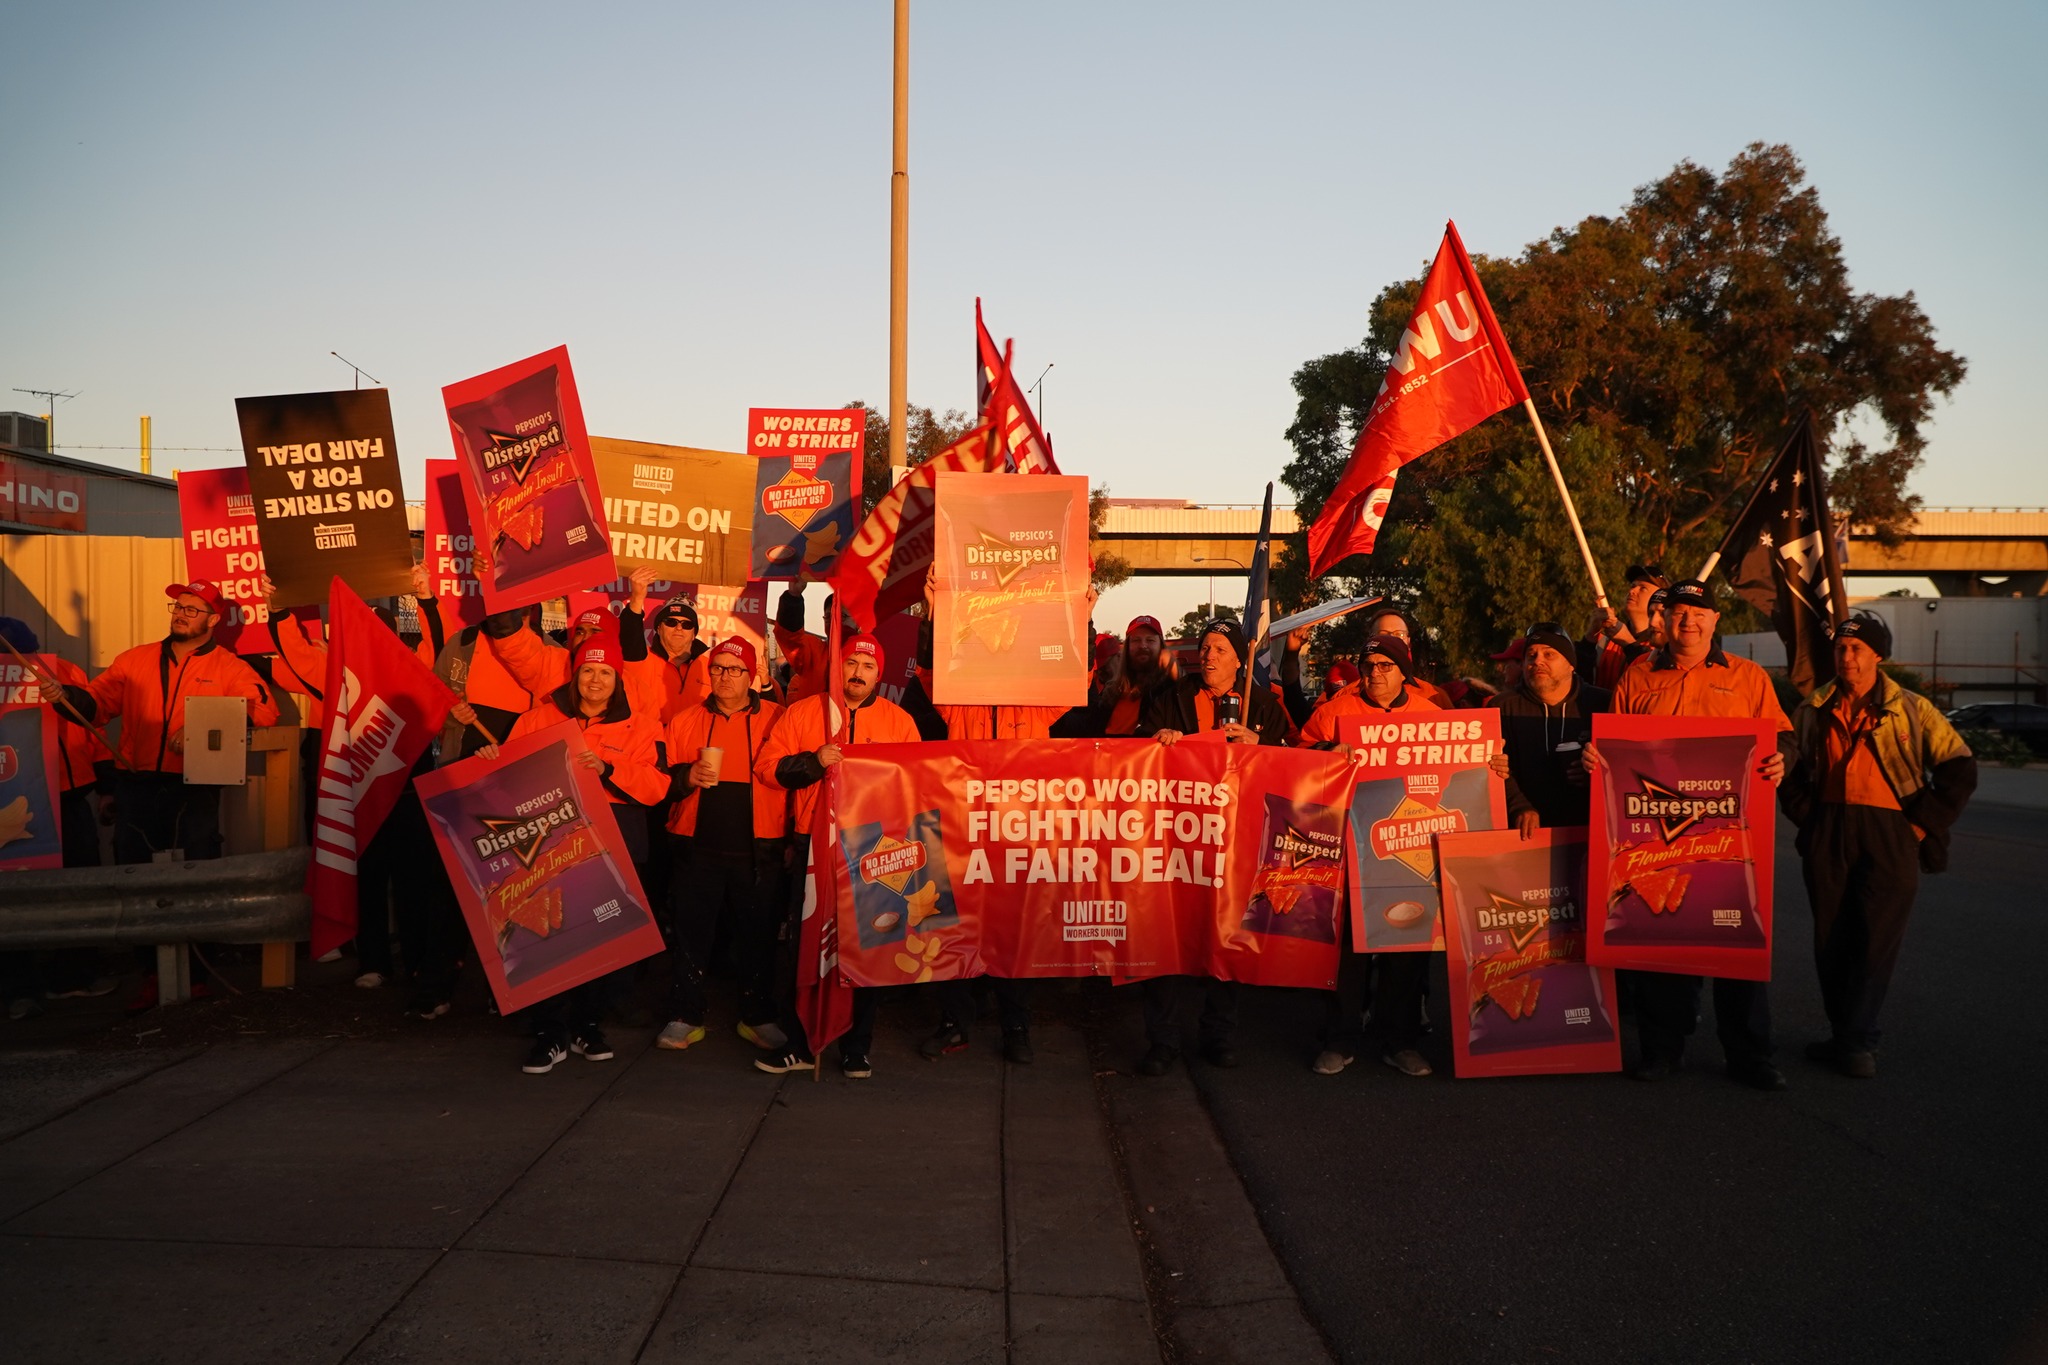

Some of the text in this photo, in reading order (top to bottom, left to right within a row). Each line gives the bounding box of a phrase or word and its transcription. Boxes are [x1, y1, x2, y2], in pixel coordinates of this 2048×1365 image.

[1377, 374, 1429, 414] Est. 1852
[515, 411, 552, 434] PEPSICO'S
[763, 416, 852, 431] WORKERS
[483, 425, 561, 469] Disrespect
[754, 432, 859, 448] ON STRIKE!
[257, 438, 384, 466] FAIR DEAL
[287, 466, 362, 490] FOR A
[492, 471, 507, 484] IS A
[535, 462, 565, 491] Insult
[634, 464, 673, 481] UNITED
[0, 481, 79, 513] HINO
[769, 485, 825, 501] NO FLAVOUR
[773, 495, 823, 508] WITHOUT US!
[264, 489, 393, 519] ON STRIKE
[687, 507, 731, 534] ON
[315, 534, 357, 550] UNITED
[565, 525, 585, 539] UNITED
[1009, 531, 1053, 541] PEPSICO'S
[967, 545, 1057, 567] Disrespect
[971, 571, 987, 580] IS A
[1019, 580, 1056, 599] Insult
[695, 593, 759, 614] STRIKE
[723, 616, 737, 632] A
[1040, 645, 1063, 654] UNITED
[1360, 721, 1482, 744] WORKERS
[1396, 740, 1494, 765] STRIKE!
[1408, 775, 1439, 785] UNITED
[1678, 780, 1731, 790] PEPSICO'S
[515, 788, 563, 816] PEPSICO'S
[966, 778, 1230, 807] PEPSICO WORKERS
[1627, 796, 1736, 821] Disrespect
[476, 801, 576, 858] Disrespect
[968, 809, 1226, 845] FIGHTING FOR
[1308, 831, 1341, 844] PEPSICO'S
[1379, 816, 1456, 840] NO FLAVOUR
[1632, 823, 1651, 833] IS A
[547, 838, 585, 871] Insult
[1275, 835, 1341, 860] Disrespect
[1686, 836, 1734, 856] Insult
[489, 858, 510, 872] IS A
[866, 846, 918, 869] NO FLAVOUR
[870, 856, 917, 877] WITHOUT US!
[963, 847, 1226, 889] A FAIR DEAL!
[1522, 886, 1569, 901] PEPSICO'S
[593, 899, 619, 916] UNITED
[1063, 900, 1127, 924] UNITED
[1478, 902, 1575, 928] Disrespect
[1713, 910, 1741, 919] UNITED
[1066, 928, 1123, 938] WORKERS UNION
[1484, 934, 1502, 945] IS A
[1565, 1008, 1590, 1018] UNITED
